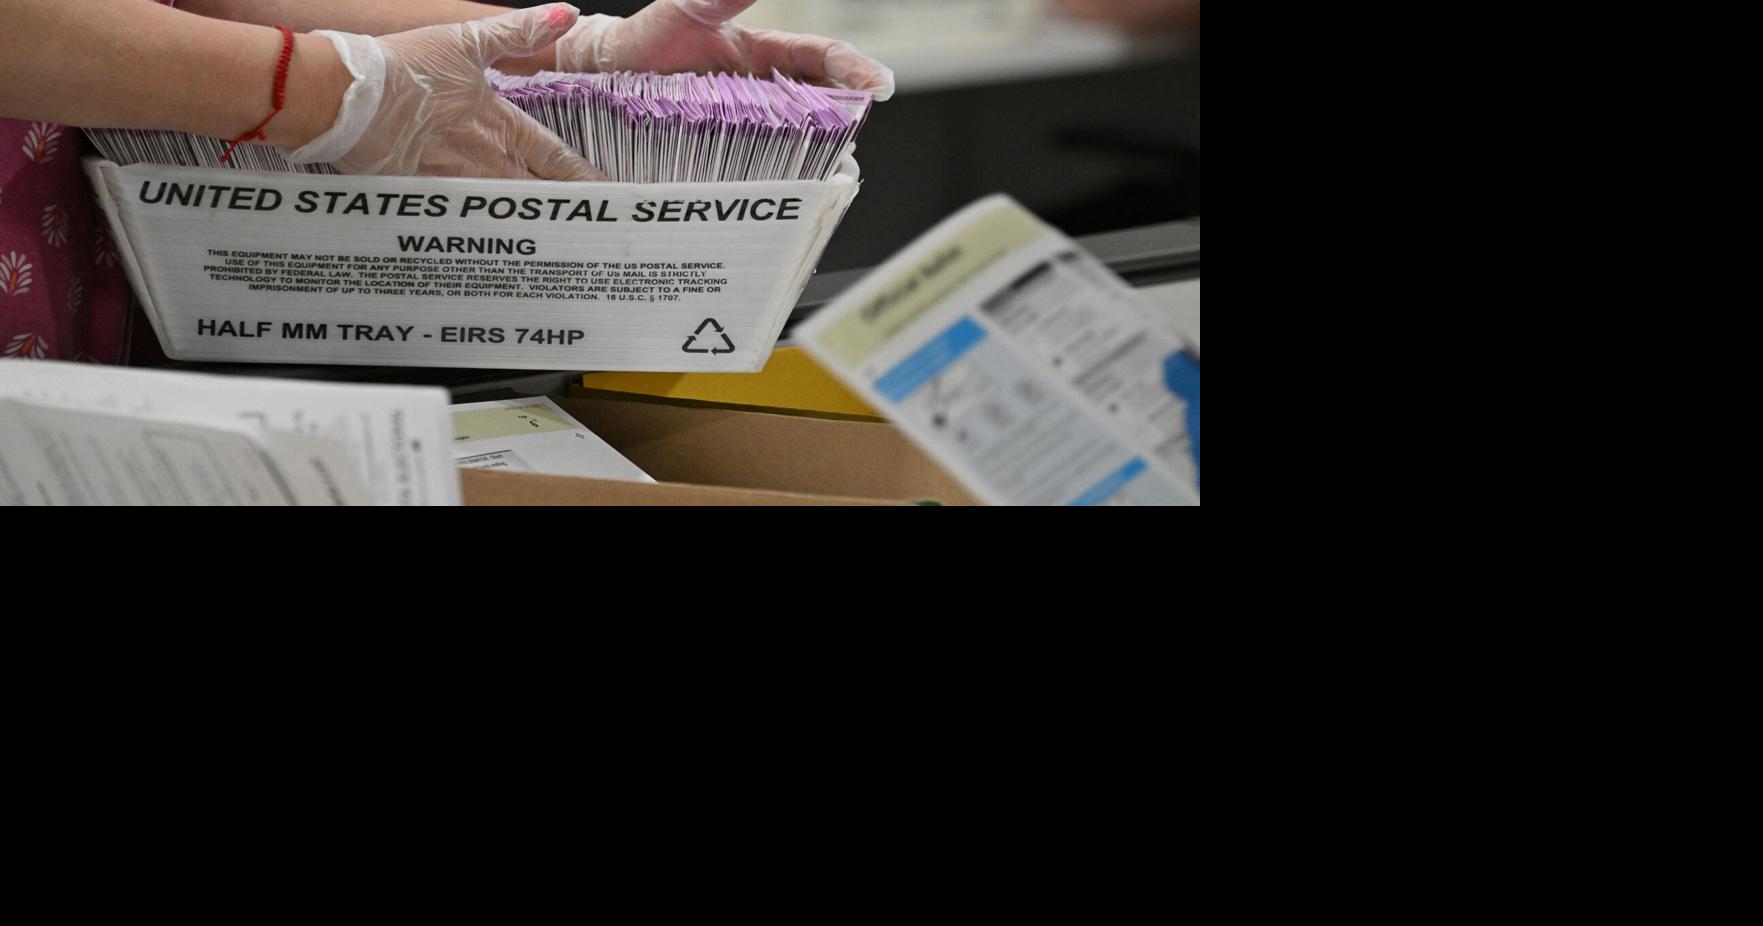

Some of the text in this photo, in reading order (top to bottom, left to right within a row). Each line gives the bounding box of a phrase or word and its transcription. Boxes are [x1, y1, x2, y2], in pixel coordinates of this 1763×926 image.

[139, 180, 802, 222] UNITED STATES POSTAL SERVICE
[397, 235, 537, 255] WARNING
[208, 249, 229, 257] THIS
[231, 250, 288, 259] EQUIPMENT
[400, 257, 453, 265] RECYCLED
[455, 258, 498, 266] WITHOUT
[524, 260, 584, 269] PERMISSION
[681, 262, 726, 270] SERVICE.
[264, 260, 284, 268] THIS
[288, 261, 344, 270] EQUIPMENT
[347, 263, 367, 271] FOR
[393, 265, 439, 273] PURPOSE
[529, 268, 588, 276] TRANSPORT
[203, 265, 263, 275] PROHIBITED
[281, 269, 326, 277] FEDERAL
[380, 272, 419, 280] POSTAL
[422, 273, 464, 281] SERVICE
[542, 276, 572, 284] RIGHT
[209, 273, 277, 283] TECHNOLOGY
[365, 280, 415, 288] LOCATION
[465, 282, 523, 290] EQUIPMENT.
[529, 284, 584, 292] VIOLATORS
[249, 283, 323, 293] IMPRISONMENT
[409, 289, 444, 297] YEARS,
[516, 291, 543, 299] EACH
[545, 292, 599, 300] VIOLATION.
[197, 319, 272, 338] HALF
[281, 322, 327, 340] MM
[337, 324, 415, 342] TRAY
[441, 326, 505, 343] EIRS
[515, 328, 585, 345] 74HP
